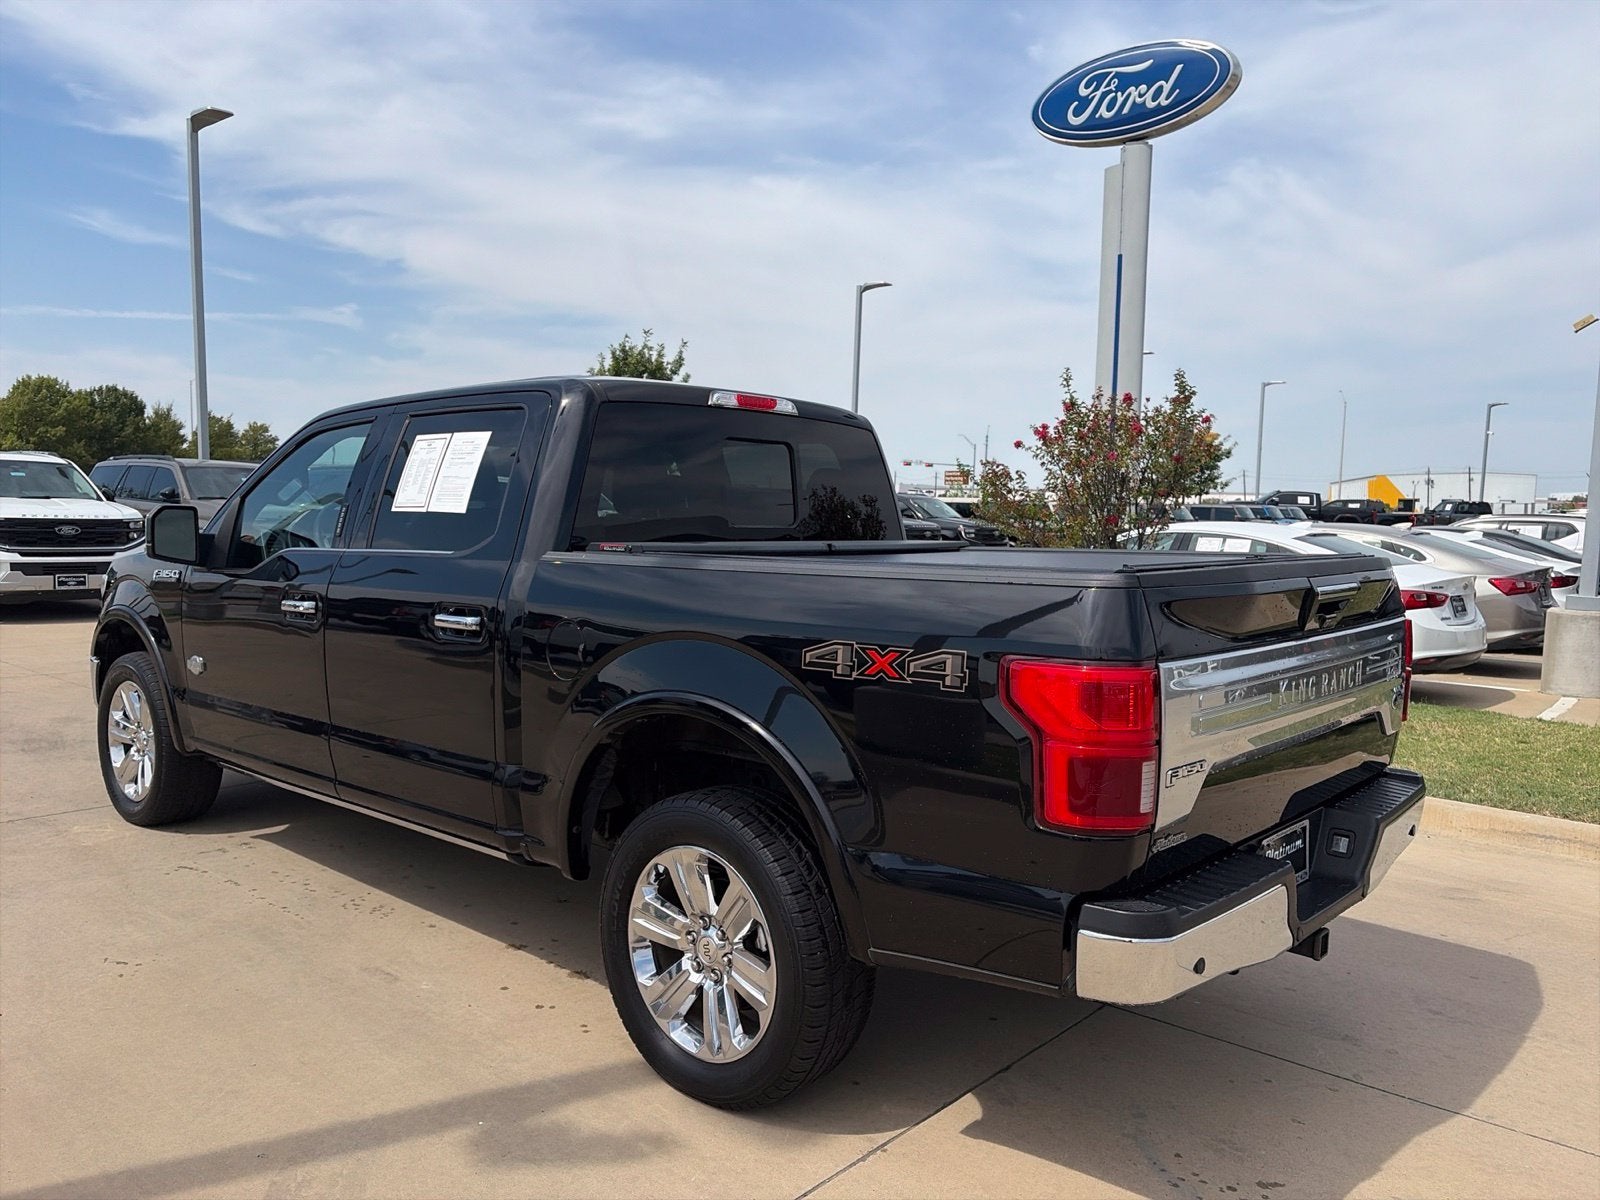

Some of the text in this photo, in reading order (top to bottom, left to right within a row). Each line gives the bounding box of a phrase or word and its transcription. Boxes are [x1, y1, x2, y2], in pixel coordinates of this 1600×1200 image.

[1066, 58, 1185, 126] Ford
[1278, 675, 1317, 706] KING
[1320, 659, 1364, 697] RANCH
[1265, 838, 1305, 861] Platinum
